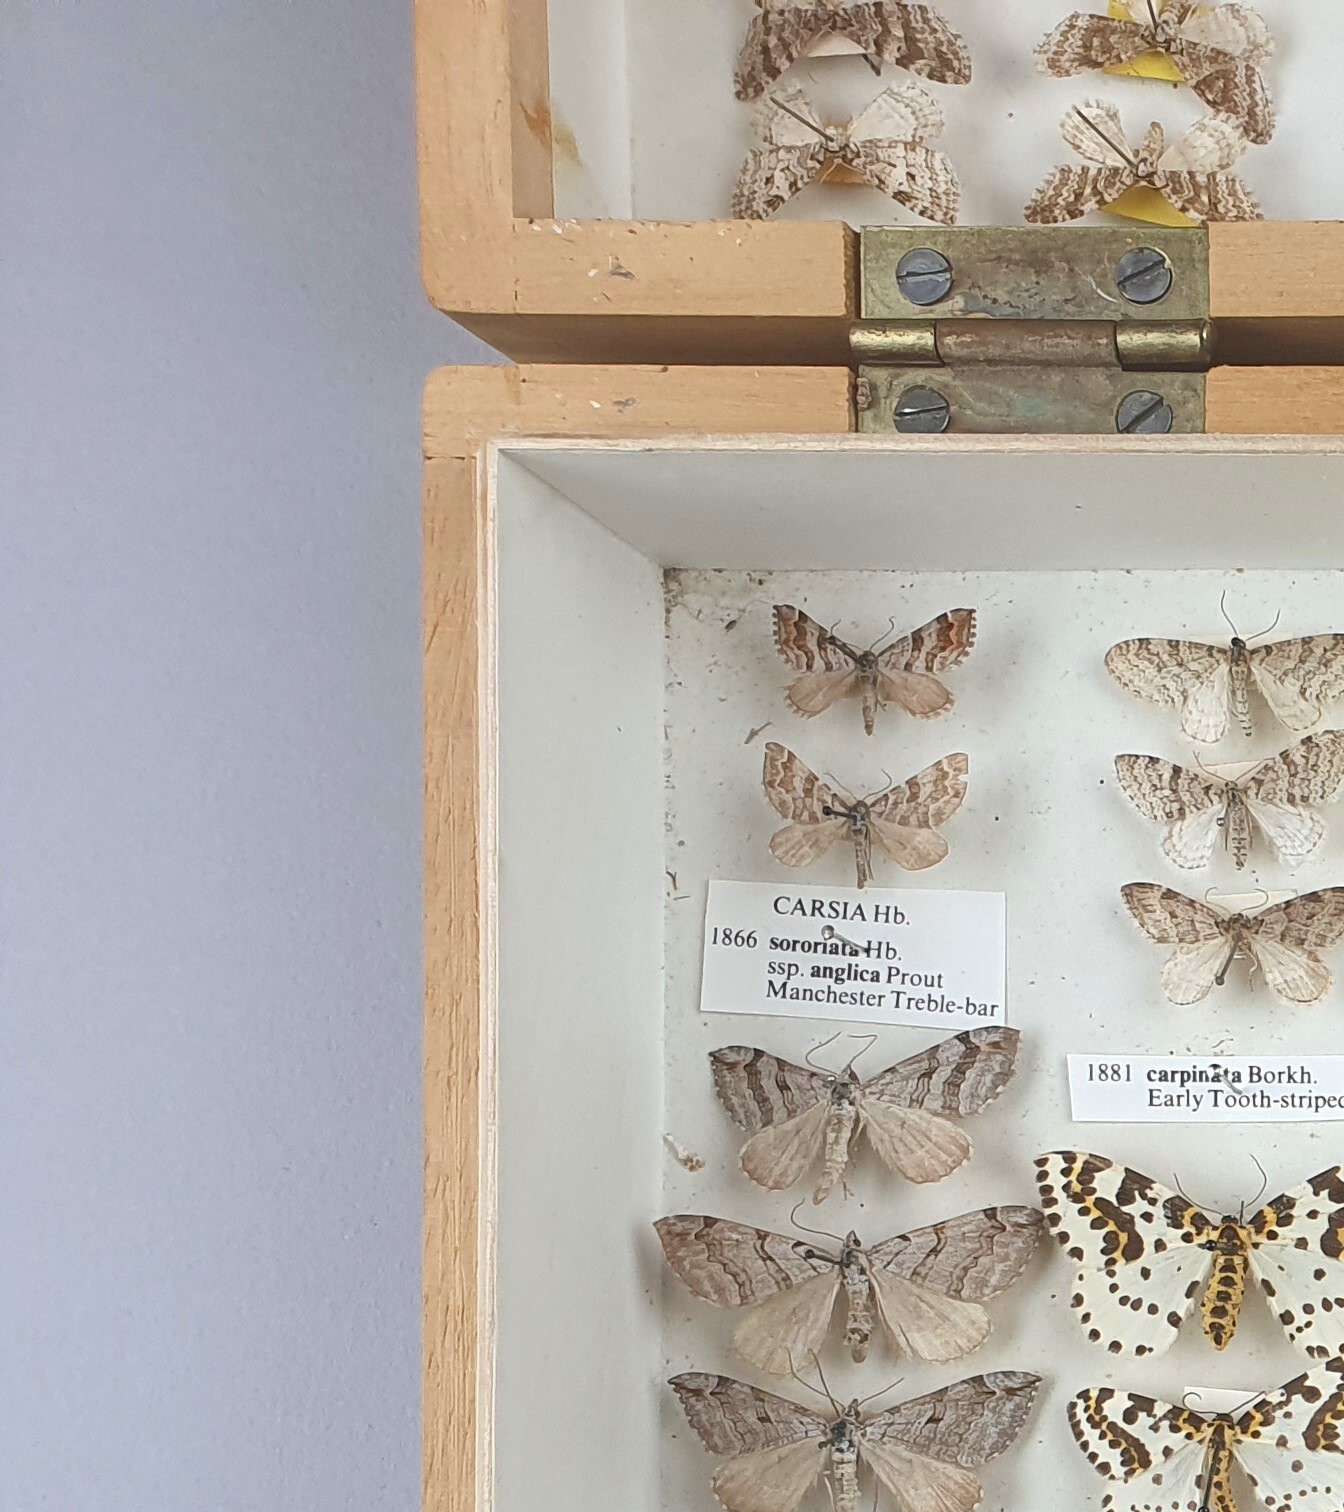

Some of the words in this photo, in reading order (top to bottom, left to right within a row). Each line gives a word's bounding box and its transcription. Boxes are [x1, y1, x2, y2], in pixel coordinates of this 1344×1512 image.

[773, 896, 867, 922] CARSIA
[873, 904, 910, 925] Hb.
[711, 927, 758, 949] 1866
[865, 940, 902, 960] Hb.
[767, 960, 804, 980] ssp.
[810, 963, 881, 984] anglica
[886, 966, 944, 989] Prout
[766, 980, 885, 1008] Manchester
[891, 990, 999, 1018] Treble-bar
[1087, 1063, 1132, 1082] 1881
[1248, 1065, 1317, 1085] Borkh.
[1148, 1089, 1203, 1112] Early
